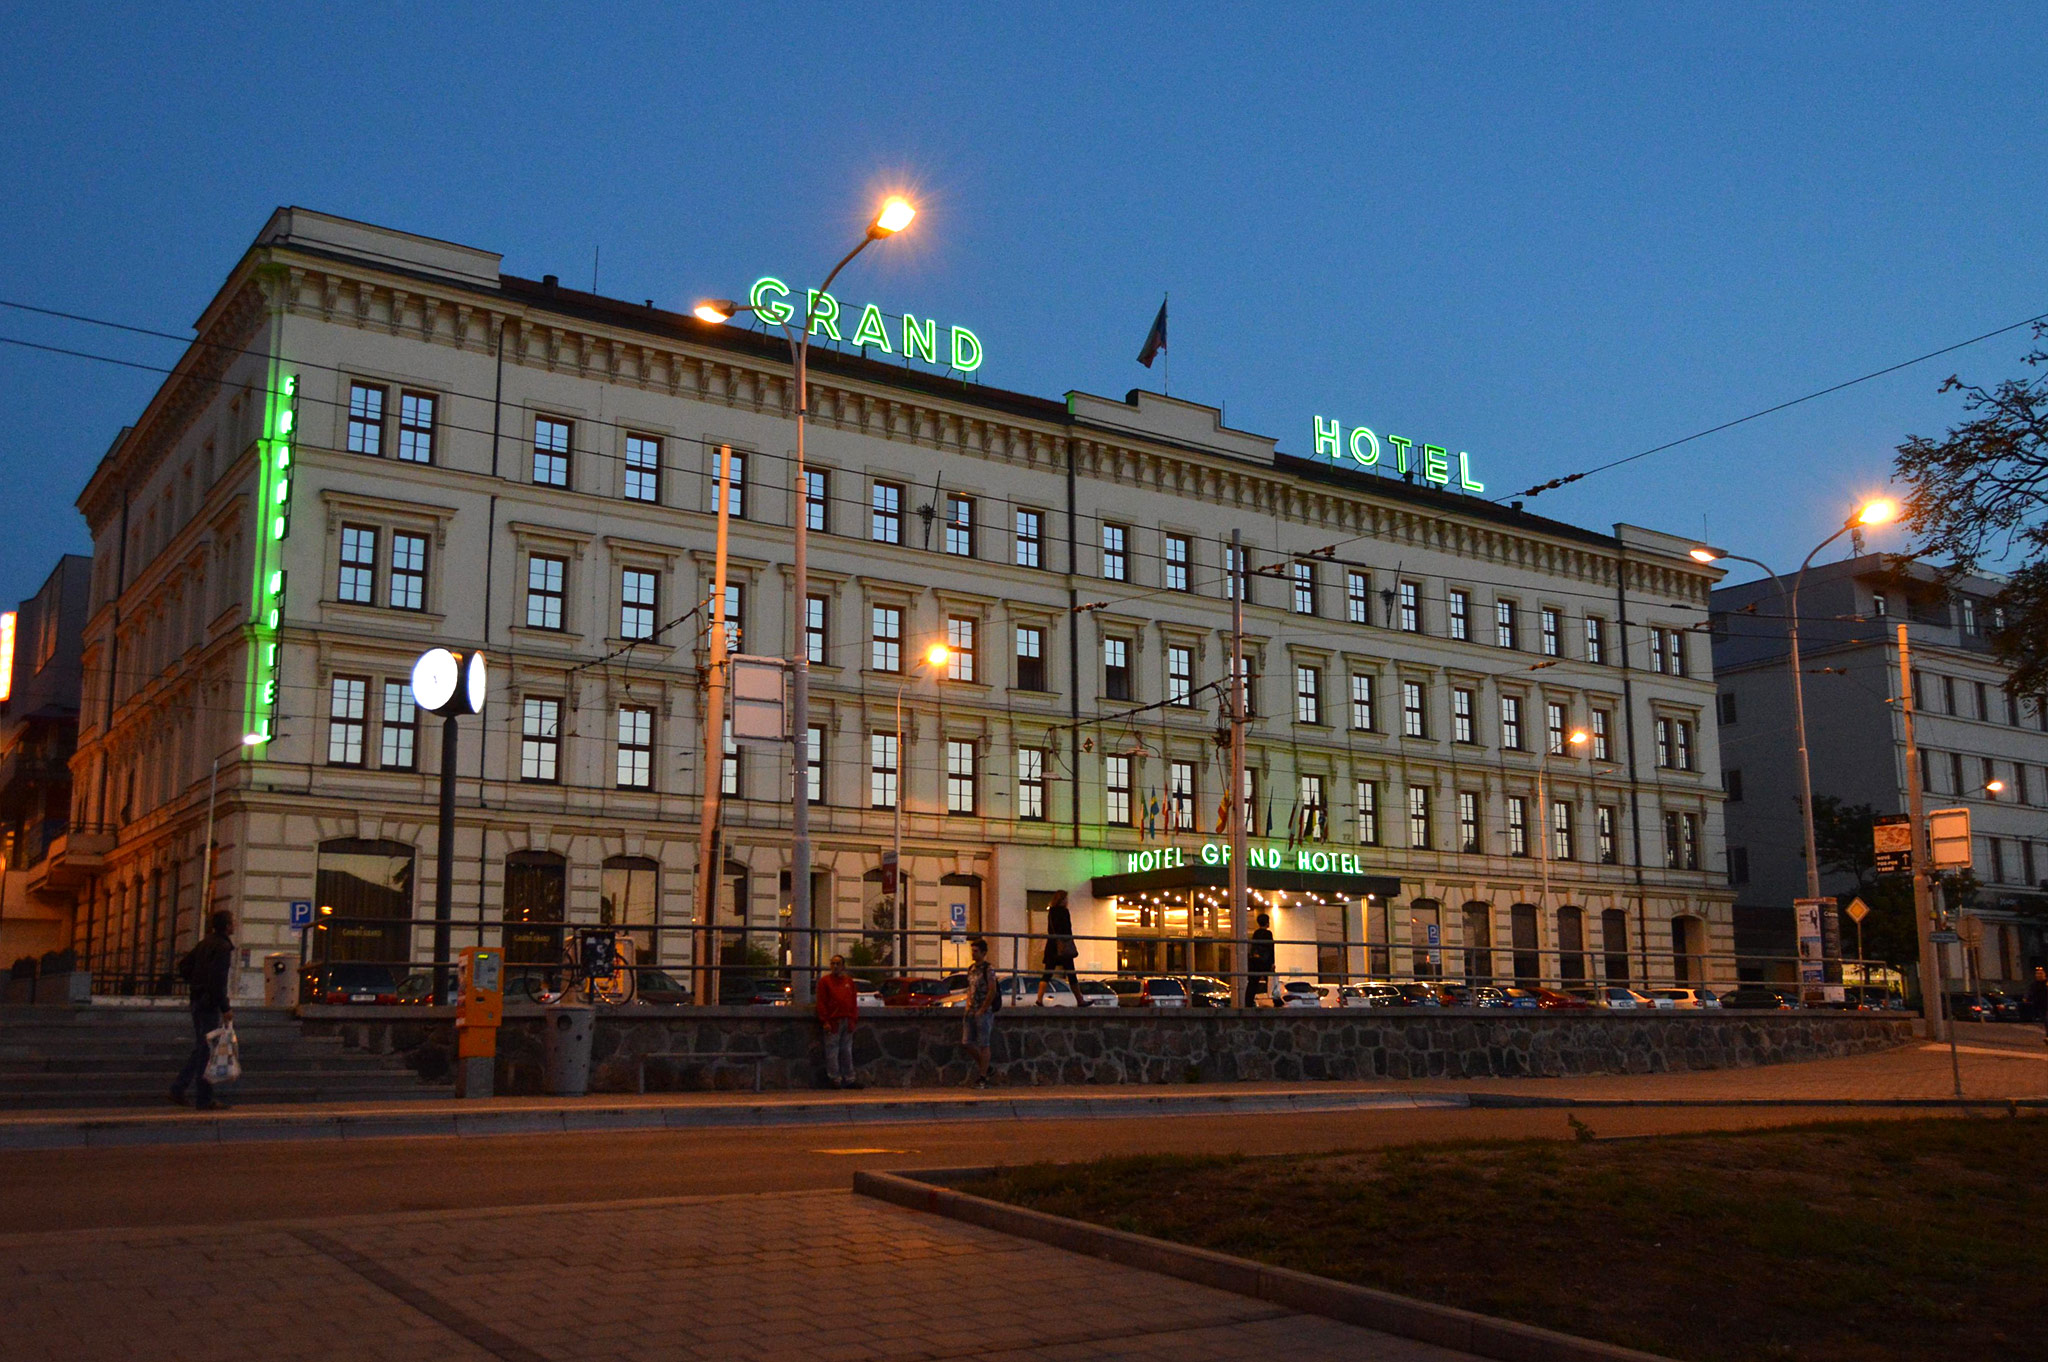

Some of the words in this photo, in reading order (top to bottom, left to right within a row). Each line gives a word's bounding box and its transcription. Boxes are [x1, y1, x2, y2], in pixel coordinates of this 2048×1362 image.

[750, 277, 982, 372] GRAND
[1314, 415, 1484, 493] HOTEL
[274, 374, 296, 541] GRAND
[261, 570, 283, 741] HOTEL
[1127, 846, 1184, 873] HOTEL
[1201, 843, 1281, 869] GRND
[1298, 850, 1364, 875] HOTEL
[295, 904, 309, 921] P
[953, 906, 963, 920] P
[1429, 926, 1437, 939] P
